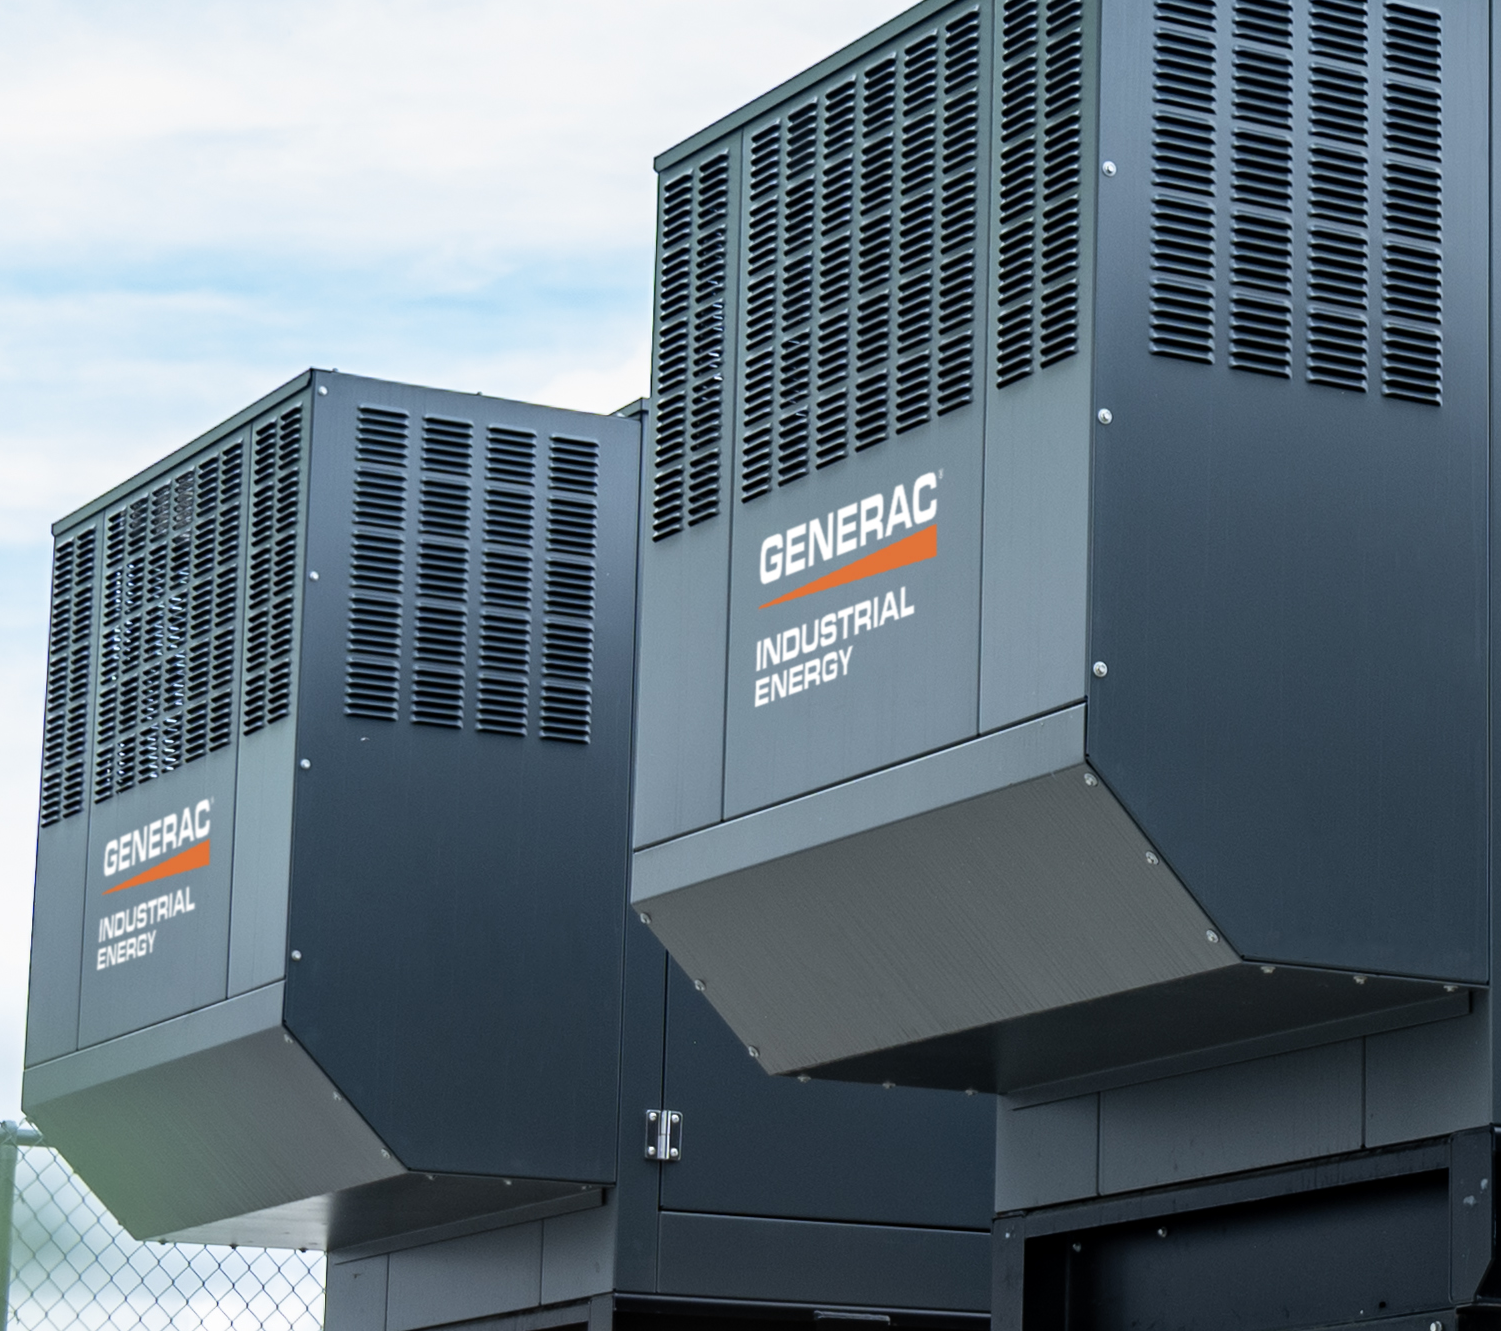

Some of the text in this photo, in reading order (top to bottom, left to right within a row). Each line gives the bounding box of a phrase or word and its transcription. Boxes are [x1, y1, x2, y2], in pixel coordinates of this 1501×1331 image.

[759, 472, 938, 585] GENERAC
[755, 586, 915, 672] INDUSTRIAL
[754, 645, 853, 708] ENERGY
[103, 798, 211, 877] GENERAC
[96, 929, 157, 971] ENERGY
[98, 886, 196, 943] INDUSTRIAL
